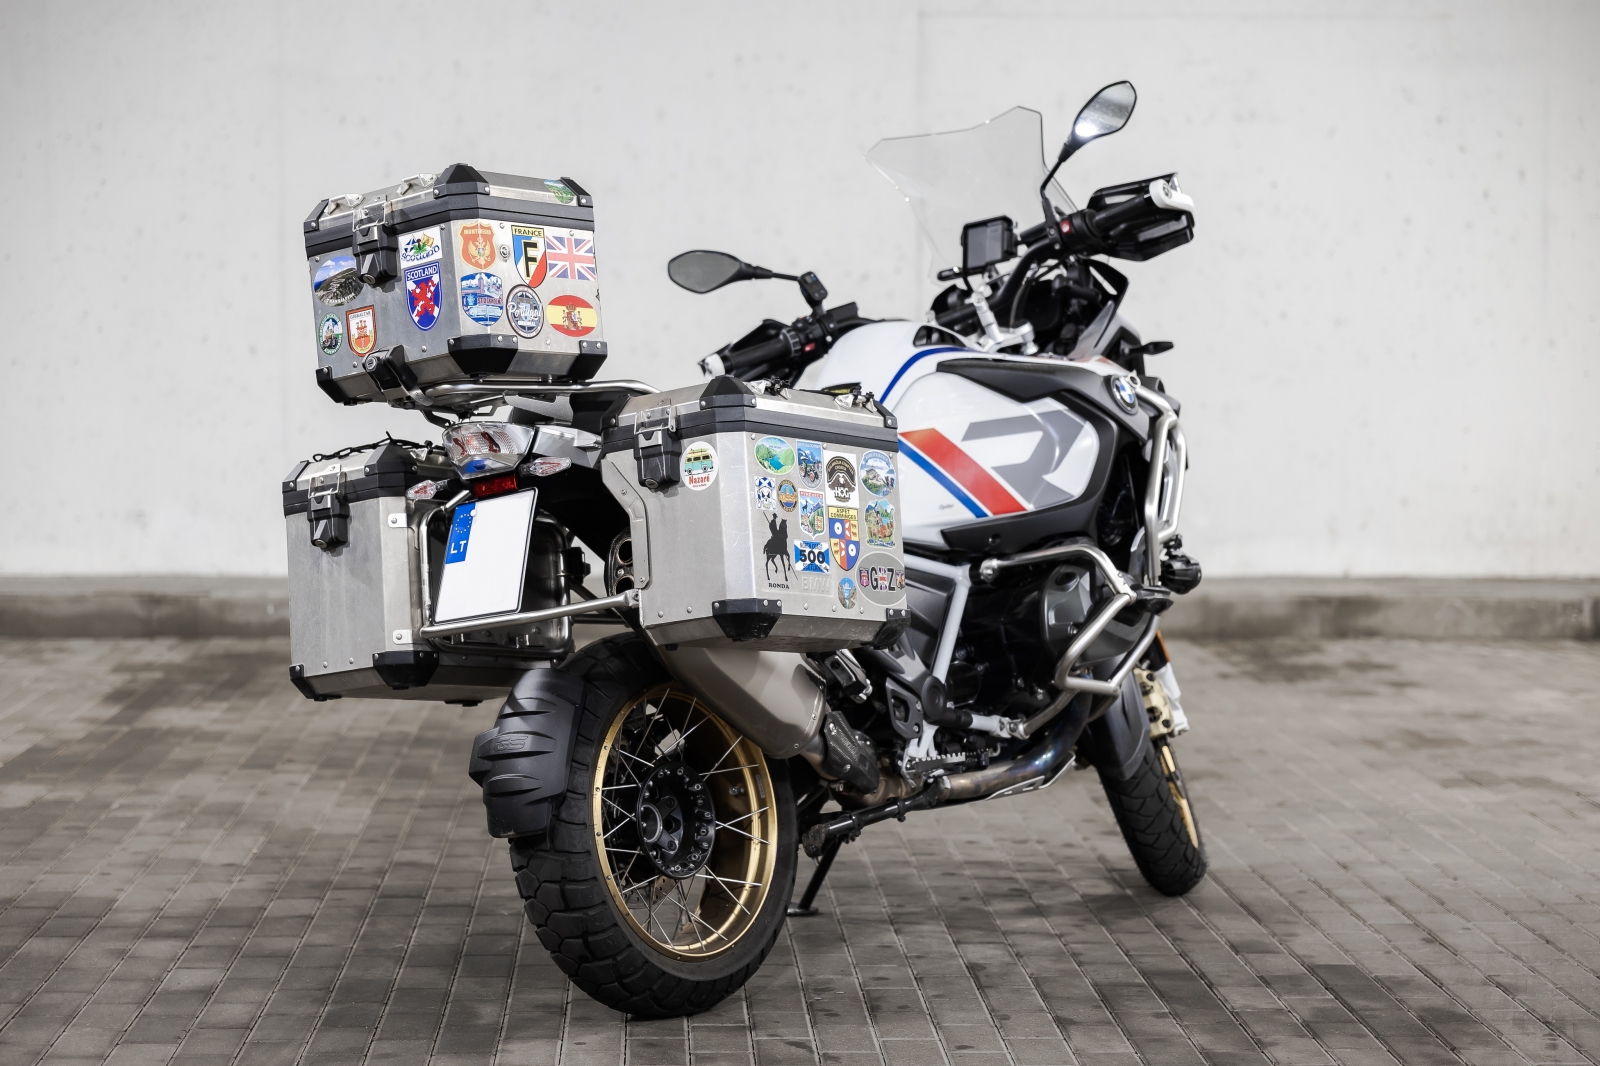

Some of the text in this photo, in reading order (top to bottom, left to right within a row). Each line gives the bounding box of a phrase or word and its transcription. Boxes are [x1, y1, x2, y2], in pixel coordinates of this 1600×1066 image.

[514, 228, 542, 237] FRANCE
[523, 241, 538, 278] F
[406, 265, 438, 280] SCOTLAND
[507, 301, 542, 321] Portugal
[688, 473, 710, 485] Nazaré
[830, 512, 857, 520] COMMINGES
[450, 540, 467, 554] LT
[799, 549, 826, 564] 500
[768, 582, 790, 590] RONDA
[495, 735, 529, 751] GS
